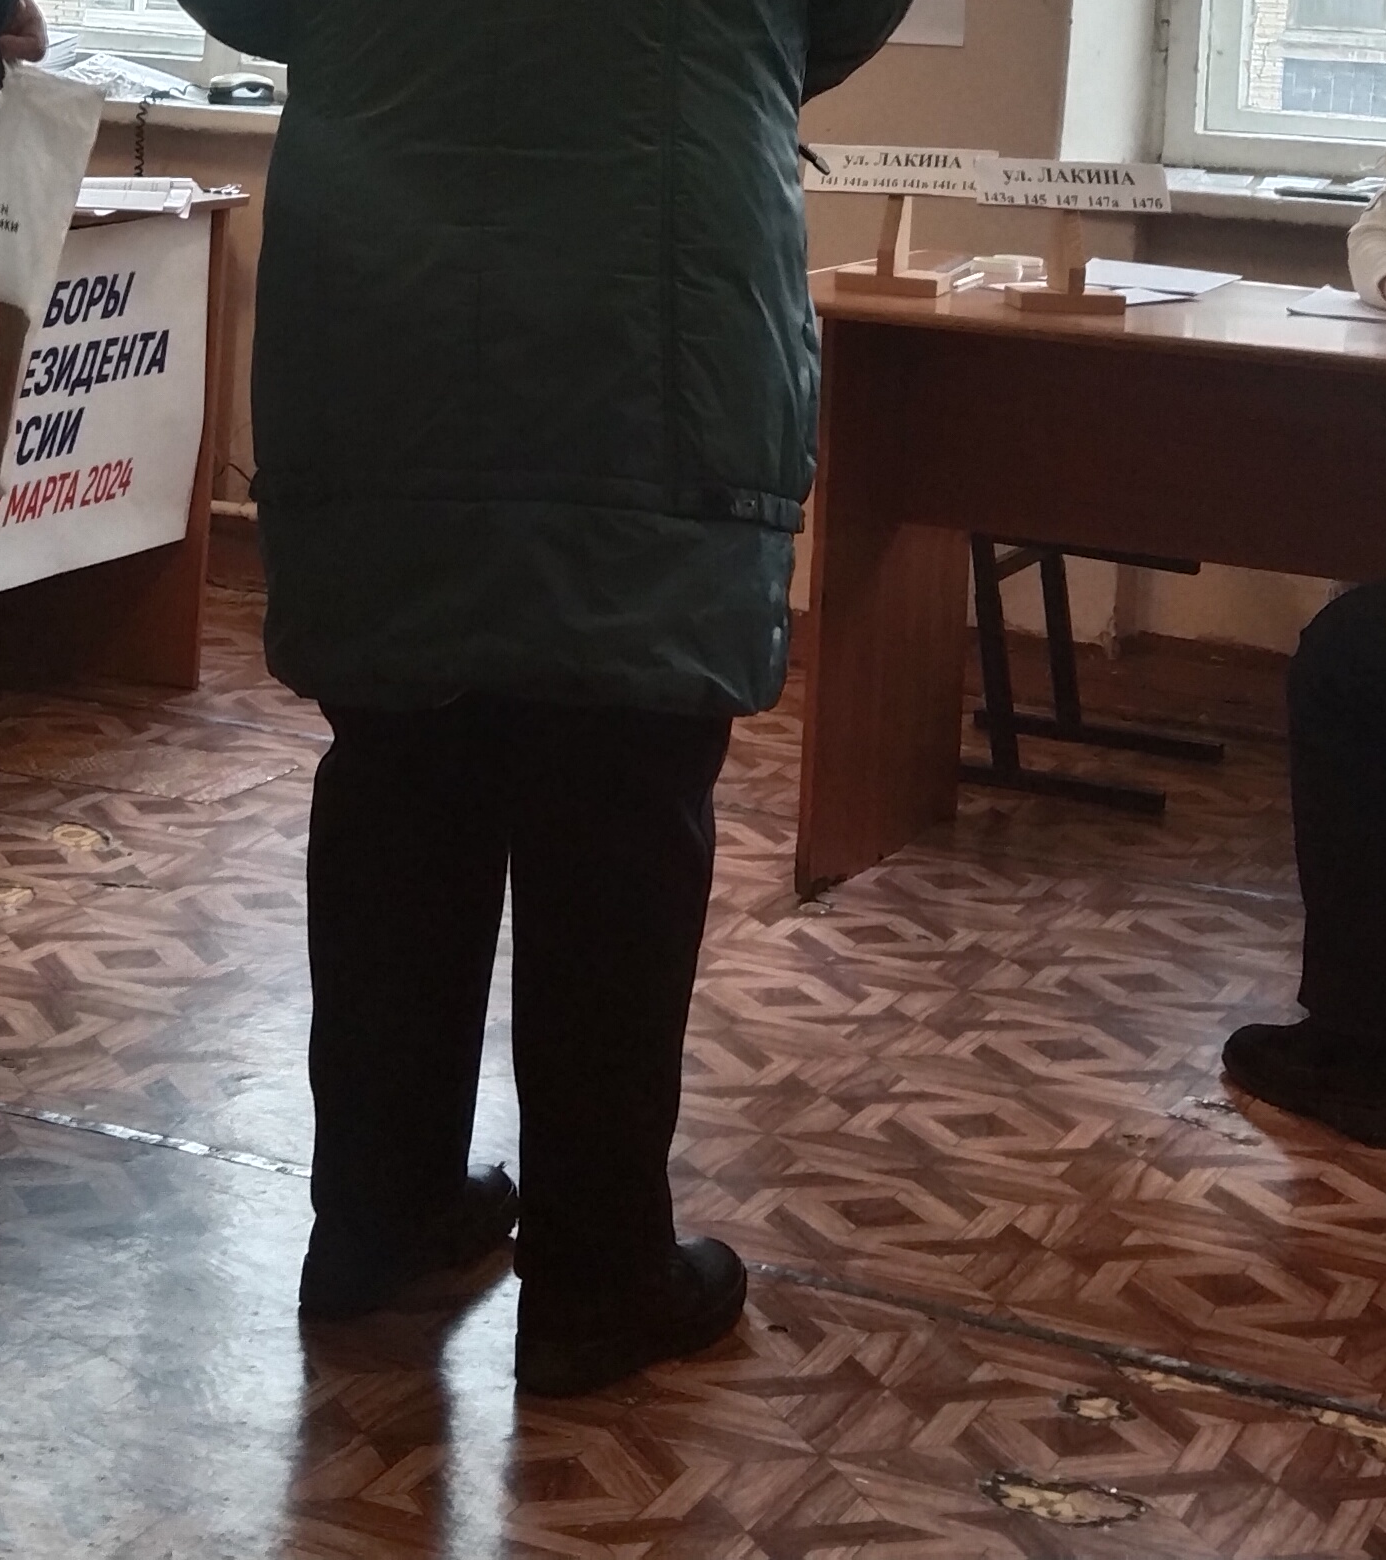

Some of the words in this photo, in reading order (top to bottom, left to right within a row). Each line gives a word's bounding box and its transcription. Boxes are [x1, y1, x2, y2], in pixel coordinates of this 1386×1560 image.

[843, 154, 870, 169] ул.
[873, 152, 962, 170] ЛАКИНА
[1003, 169, 1032, 186] ул.
[1037, 167, 1136, 186] ЛАКИНА
[962, 180, 977, 191] 14
[1024, 193, 1047, 205] 145
[42, 271, 136, 329] БОРЫ
[19, 329, 170, 399] ЕЗИДЕНТА
[15, 406, 86, 467] СИИ
[2, 469, 80, 528] МАРТА
[79, 457, 134, 508] 2024
